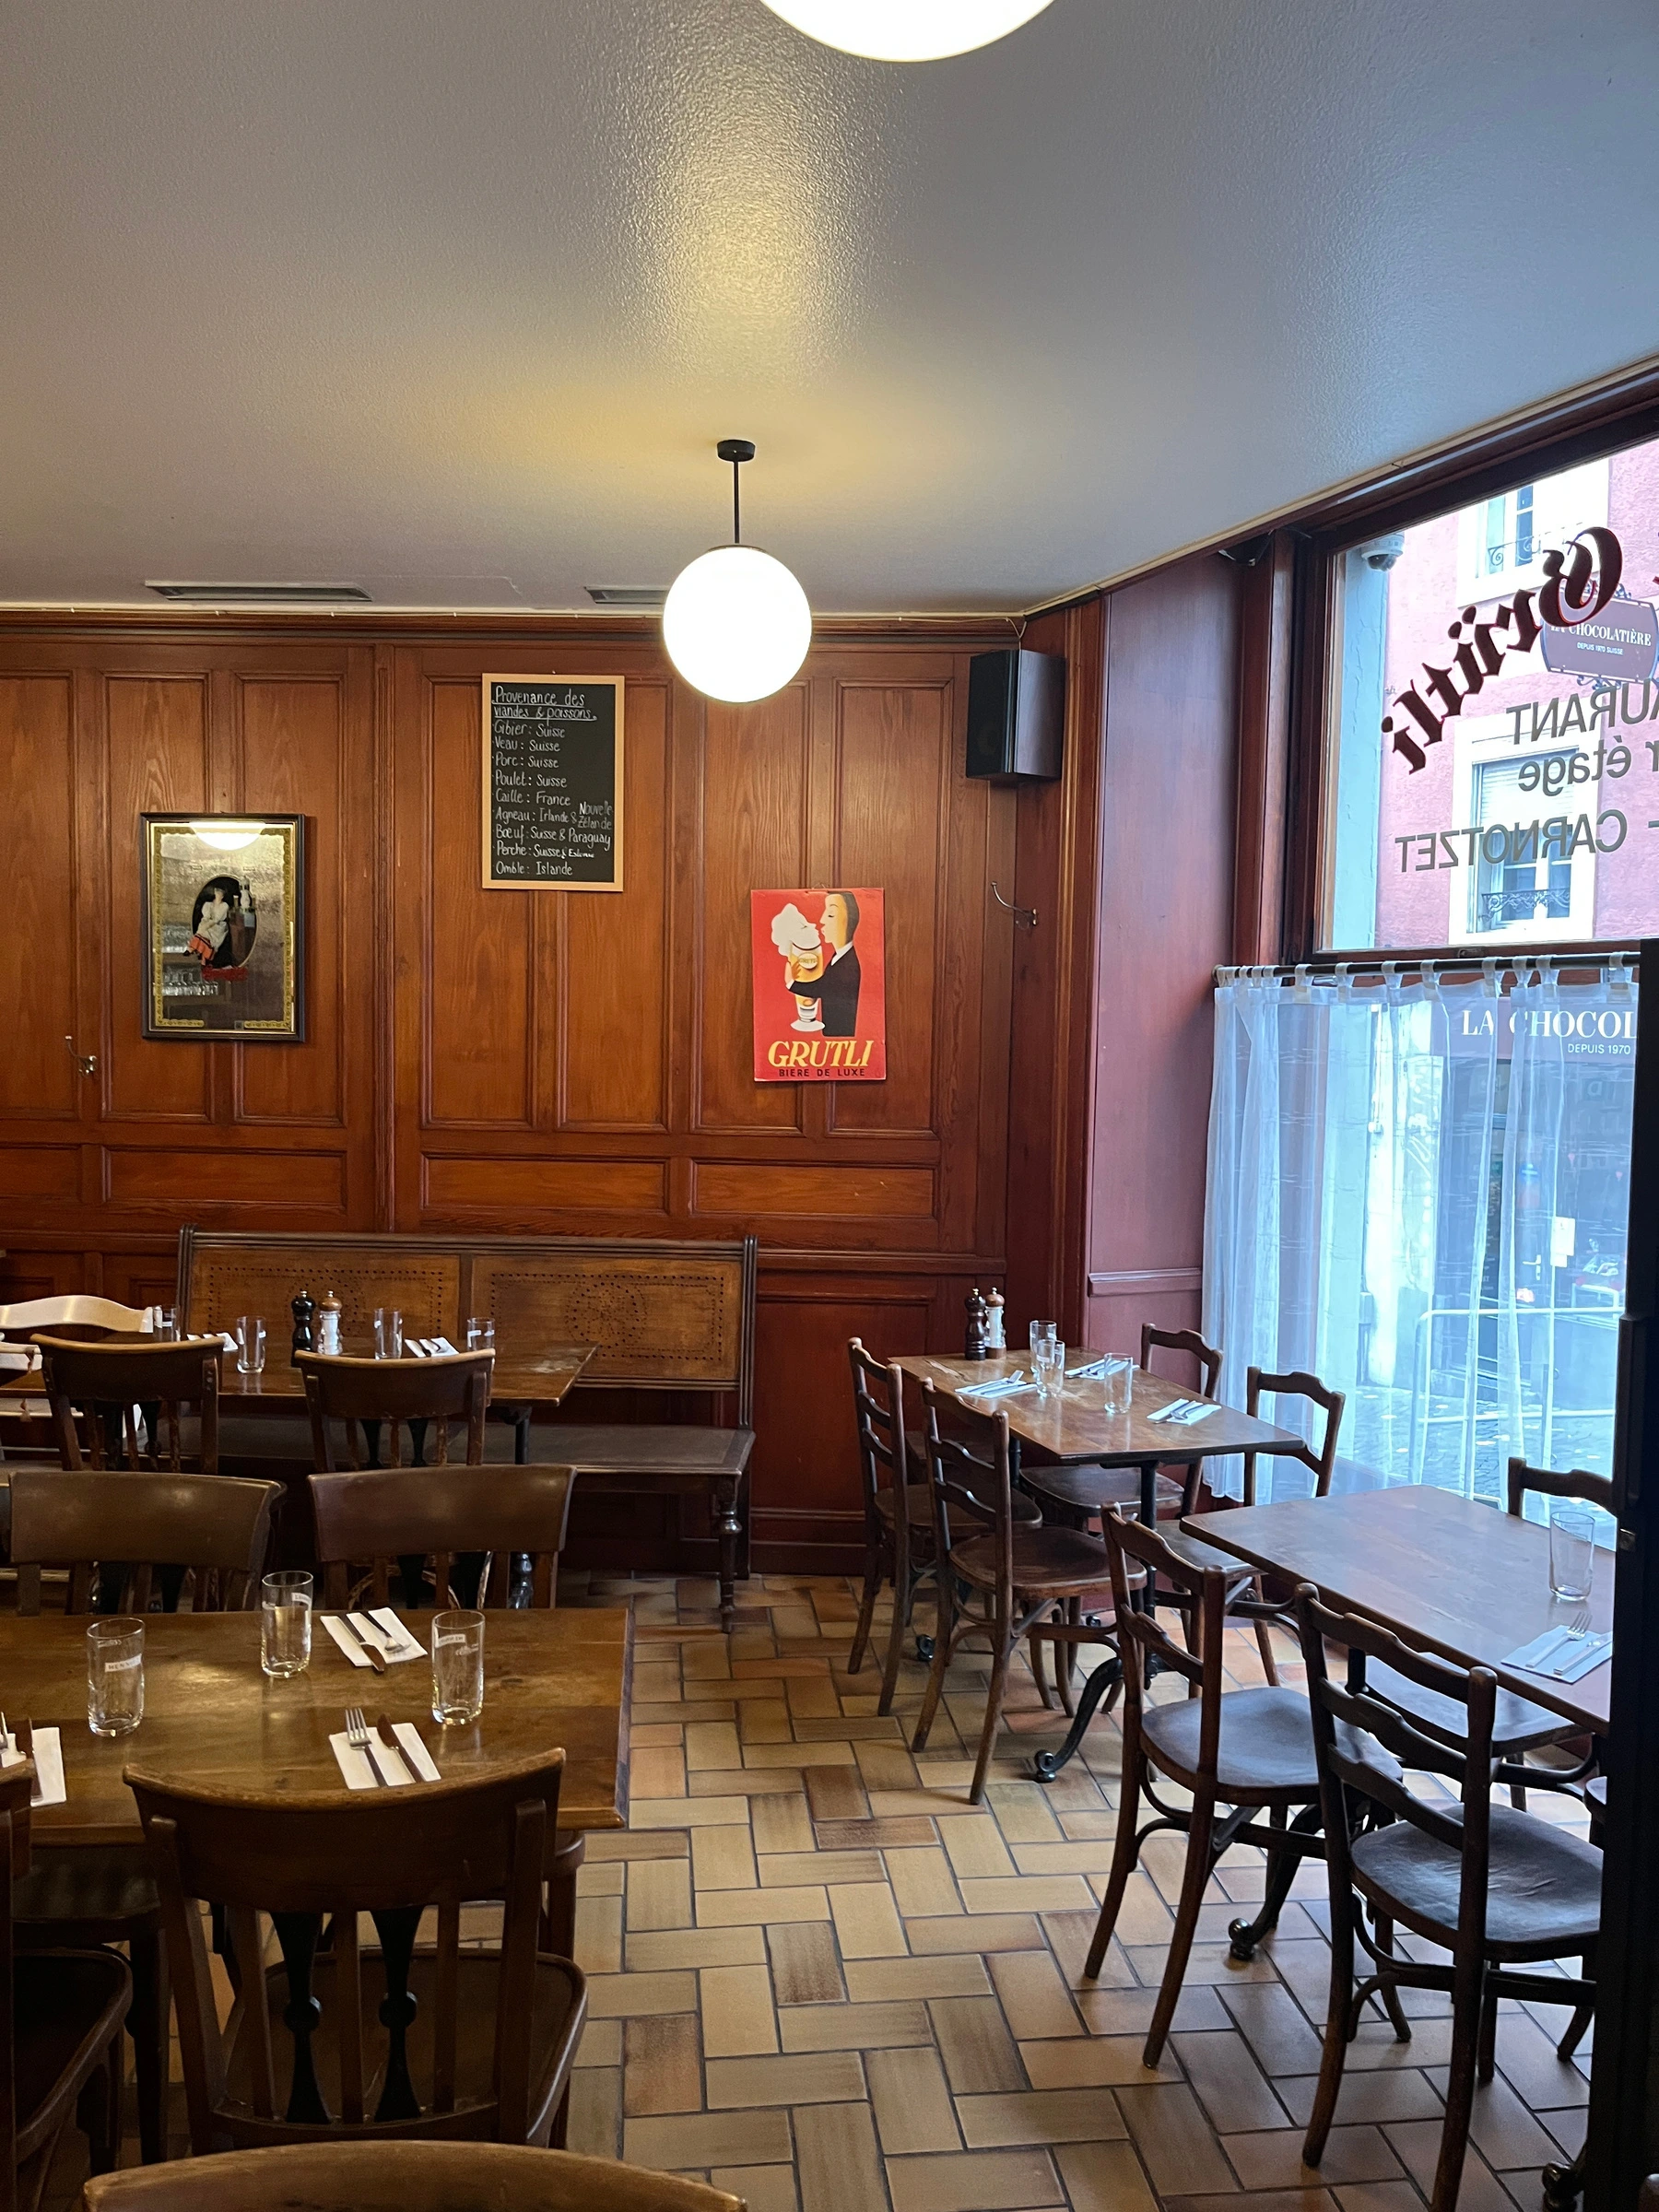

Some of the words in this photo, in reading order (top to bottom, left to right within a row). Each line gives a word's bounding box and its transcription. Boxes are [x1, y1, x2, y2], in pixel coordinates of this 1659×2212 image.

[1577, 641, 1594, 652] DEPUIS
[1606, 646, 1623, 655] SUISSE
[495, 685, 557, 706] Provenance
[565, 688, 585, 707] des
[494, 705, 529, 717] viandes
[536, 706, 545, 718] &
[535, 723, 565, 738] Suisse
[529, 739, 560, 752] Suisse
[527, 756, 559, 768] Suisse
[535, 774, 568, 788] Suisse
[535, 790, 571, 806] France
[539, 807, 570, 823] Irlande
[531, 826, 557, 841] Suisse
[559, 829, 566, 841] &
[568, 827, 611, 852] Paraguay
[533, 843, 560, 858] Suisse
[535, 861, 573, 876] Islande
[1462, 1010, 1494, 1036] LA
[768, 1040, 875, 1067] GRUTLI
[1568, 1043, 1604, 1054] DEPUIS
[1607, 1044, 1630, 1054] 1970
[779, 1068, 810, 1077] BIERE
[817, 1068, 830, 1077] DE
[837, 1068, 865, 1077] LUXE
